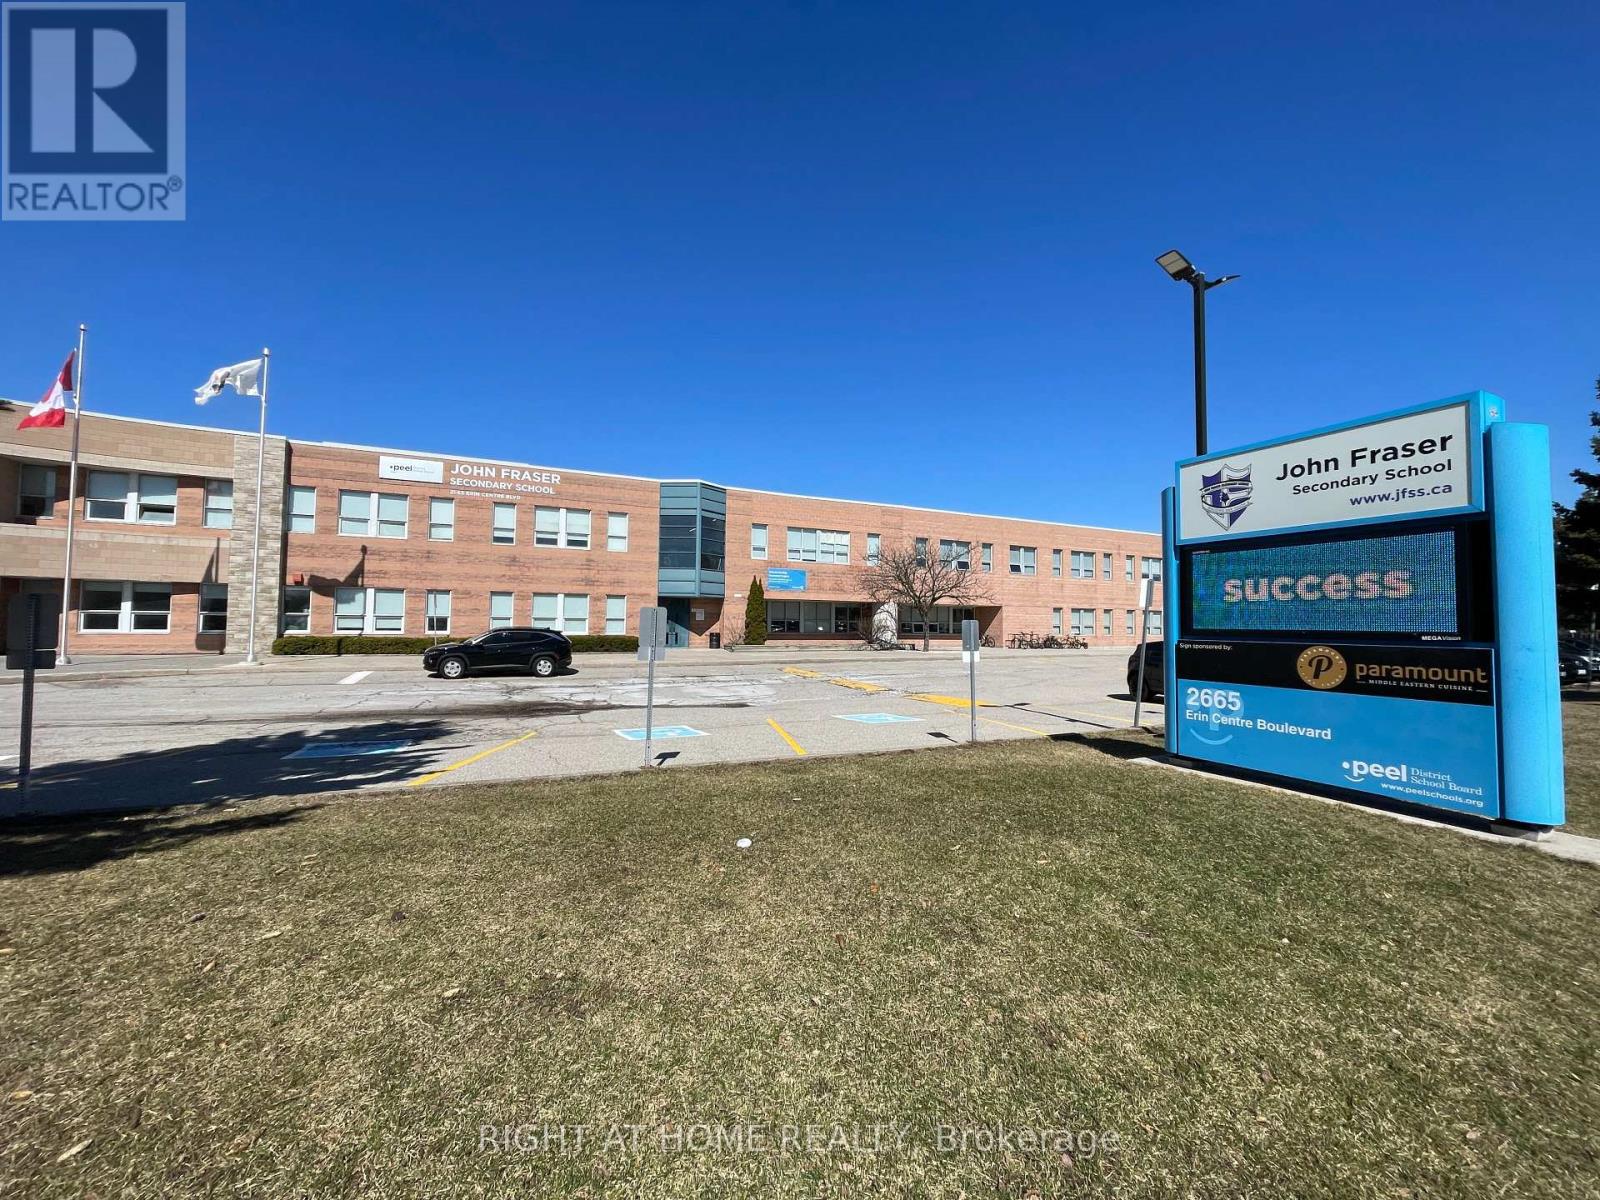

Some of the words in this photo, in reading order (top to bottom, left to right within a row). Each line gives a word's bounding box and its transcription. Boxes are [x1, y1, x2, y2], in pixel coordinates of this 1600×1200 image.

[1276, 456, 1339, 481] John
[1351, 434, 1453, 467] Fraser
[450, 463, 496, 478] JOHN
[501, 468, 561, 485] FRASER
[1292, 474, 1379, 495] Secondary
[1385, 459, 1452, 480] School
[450, 477, 513, 490] SECONDARY
[515, 483, 556, 495] SCHOOL
[1350, 484, 1453, 506] www.jfss.ca
[1222, 570, 1415, 602] success
[1355, 663, 1488, 684] paramount
[1400, 681, 1435, 689] EASTERN
[1438, 684, 1473, 692] CUISINE
[1186, 687, 1241, 711] 2665
[1186, 710, 1209, 722] Erin
[1212, 713, 1253, 728] Centre
[1257, 719, 1332, 740] Boulevard
[1352, 760, 1408, 782] peel
[1411, 768, 1452, 781] District
[1381, 783, 1484, 808] www.peelschools.org
[1411, 776, 1445, 789] School
[1450, 783, 1483, 796] Board
